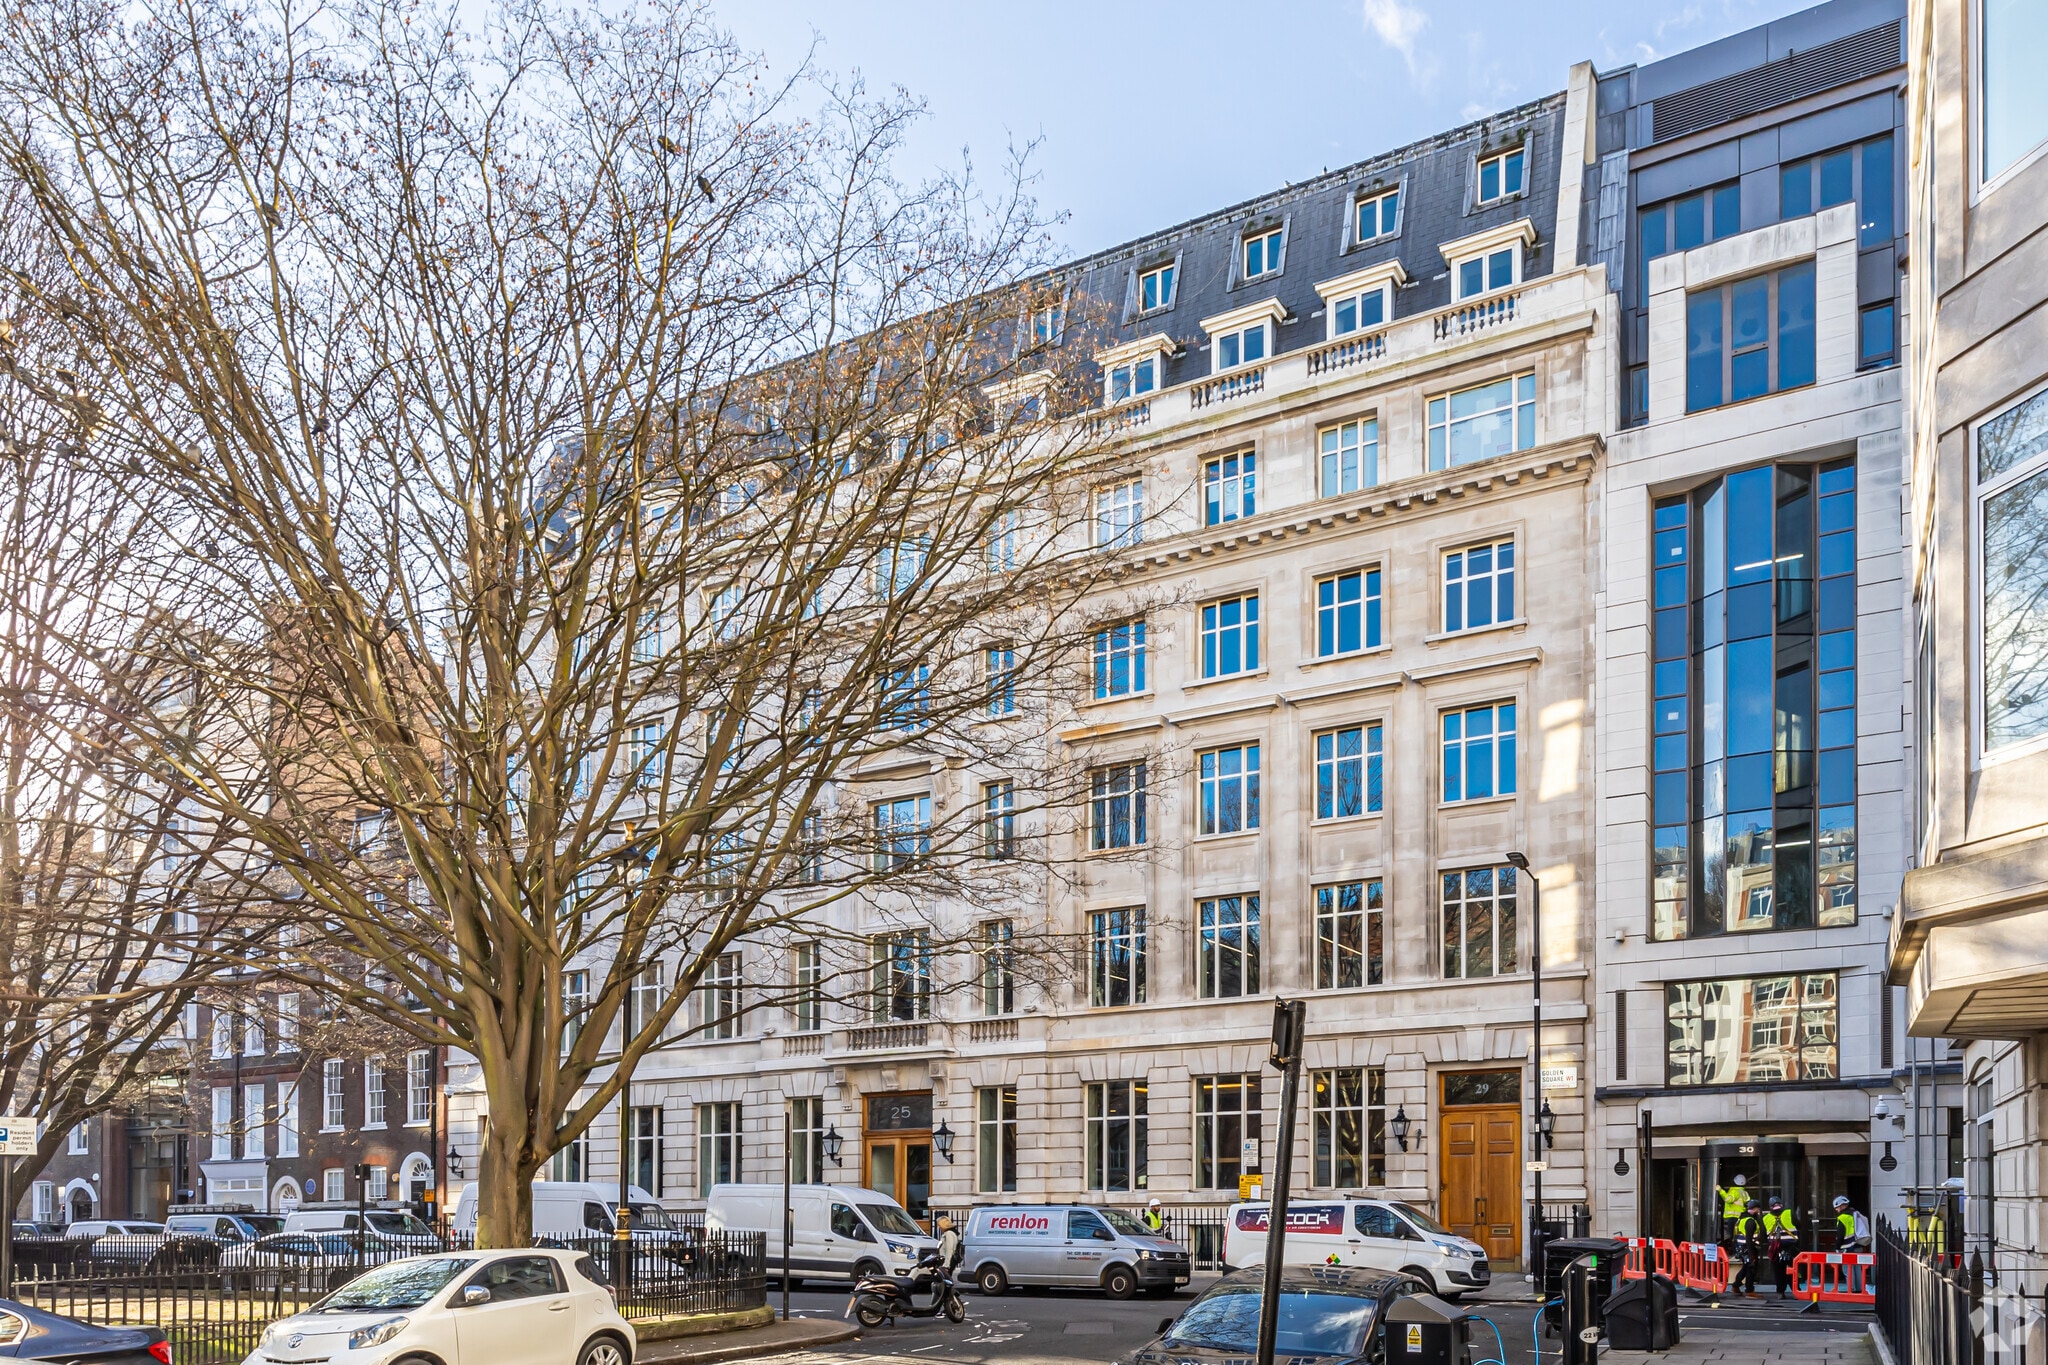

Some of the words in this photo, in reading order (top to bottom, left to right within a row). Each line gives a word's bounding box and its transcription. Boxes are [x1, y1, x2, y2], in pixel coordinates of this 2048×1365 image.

[1475, 1083, 1489, 1095] 29
[891, 1106, 911, 1119] 25
[991, 1214, 1048, 1229] renlon
[1256, 1214, 1329, 1225] ACOCK
